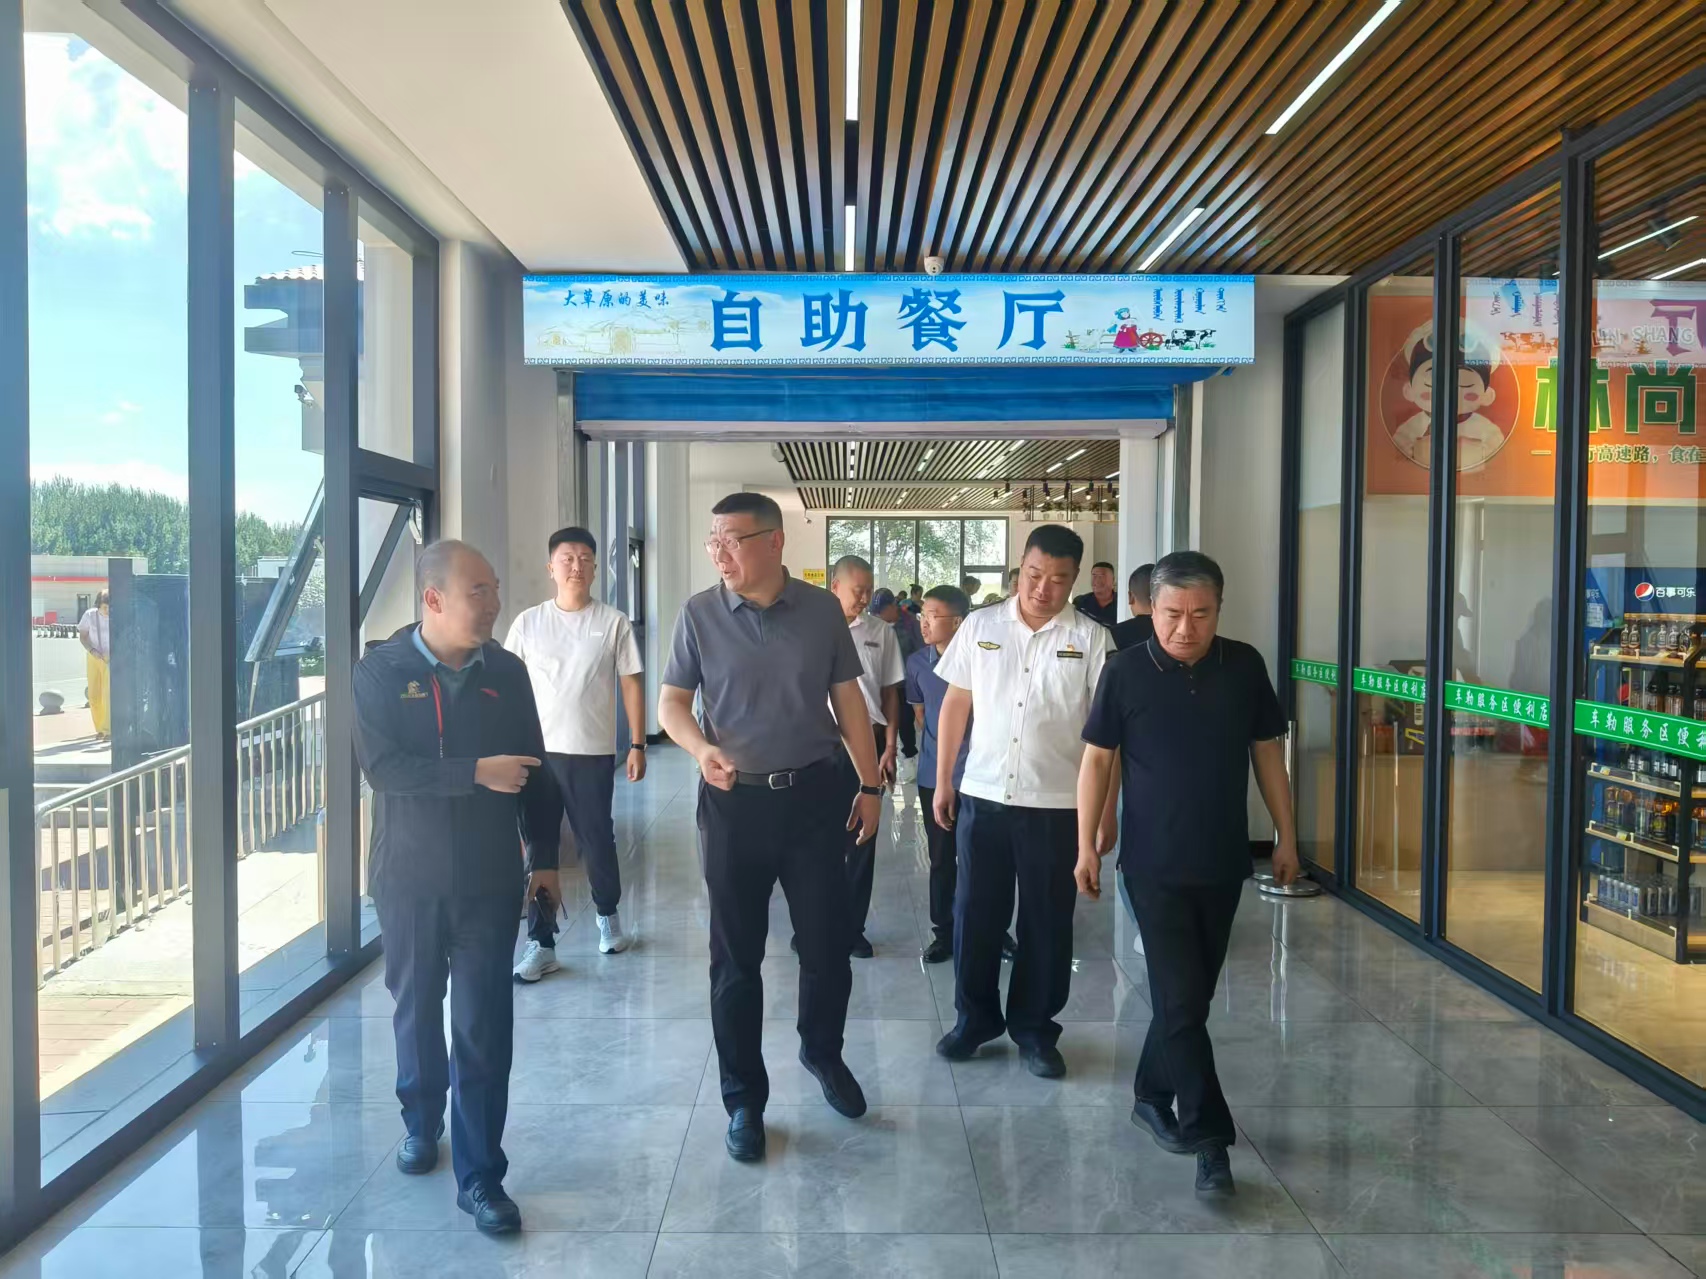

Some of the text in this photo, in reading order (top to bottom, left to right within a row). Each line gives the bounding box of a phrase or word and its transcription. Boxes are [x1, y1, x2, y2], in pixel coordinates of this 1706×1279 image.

[563, 288, 669, 309] 大草原的美味
[711, 287, 1066, 352] 自助餐厅
[1632, 325, 1696, 347] SHANG
[1655, 586, 1696, 598] 百事可乐
[1455, 688, 1548, 721] 车勒服务区便利店
